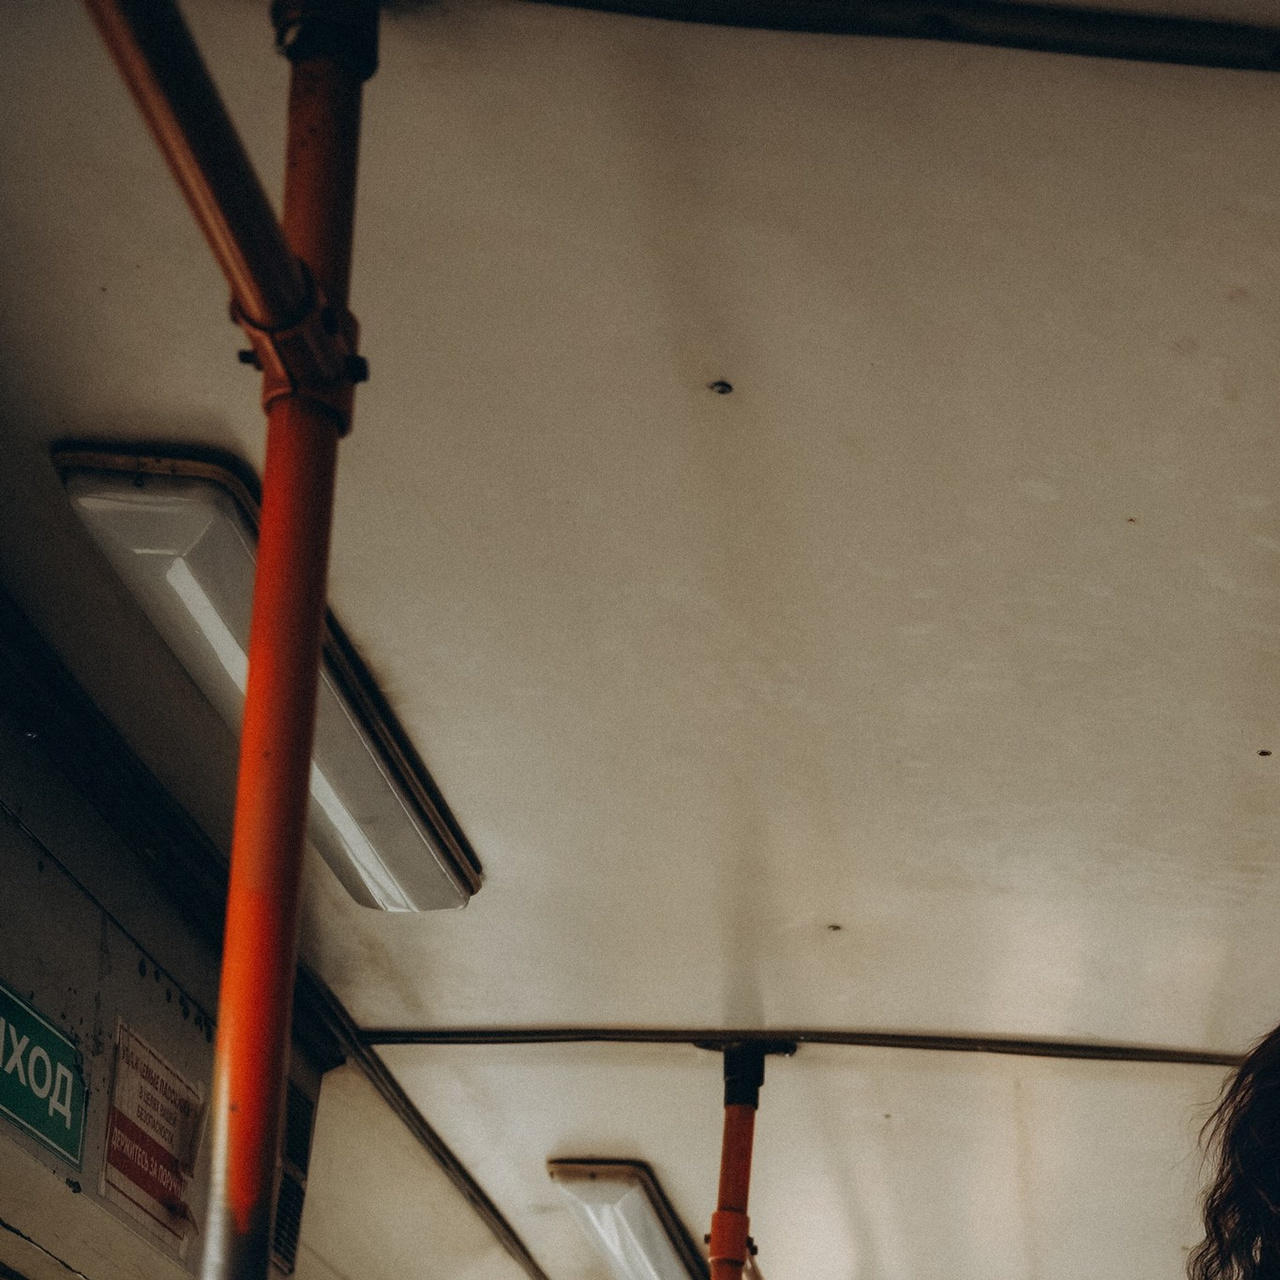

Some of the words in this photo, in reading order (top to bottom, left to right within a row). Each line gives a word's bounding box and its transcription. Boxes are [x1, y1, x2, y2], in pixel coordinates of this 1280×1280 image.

[0, 1016, 73, 1130] ХОД
[112, 1126, 150, 1171] ДЕРЖИТЕСЬ
[148, 1155, 158, 1180] ЗА
